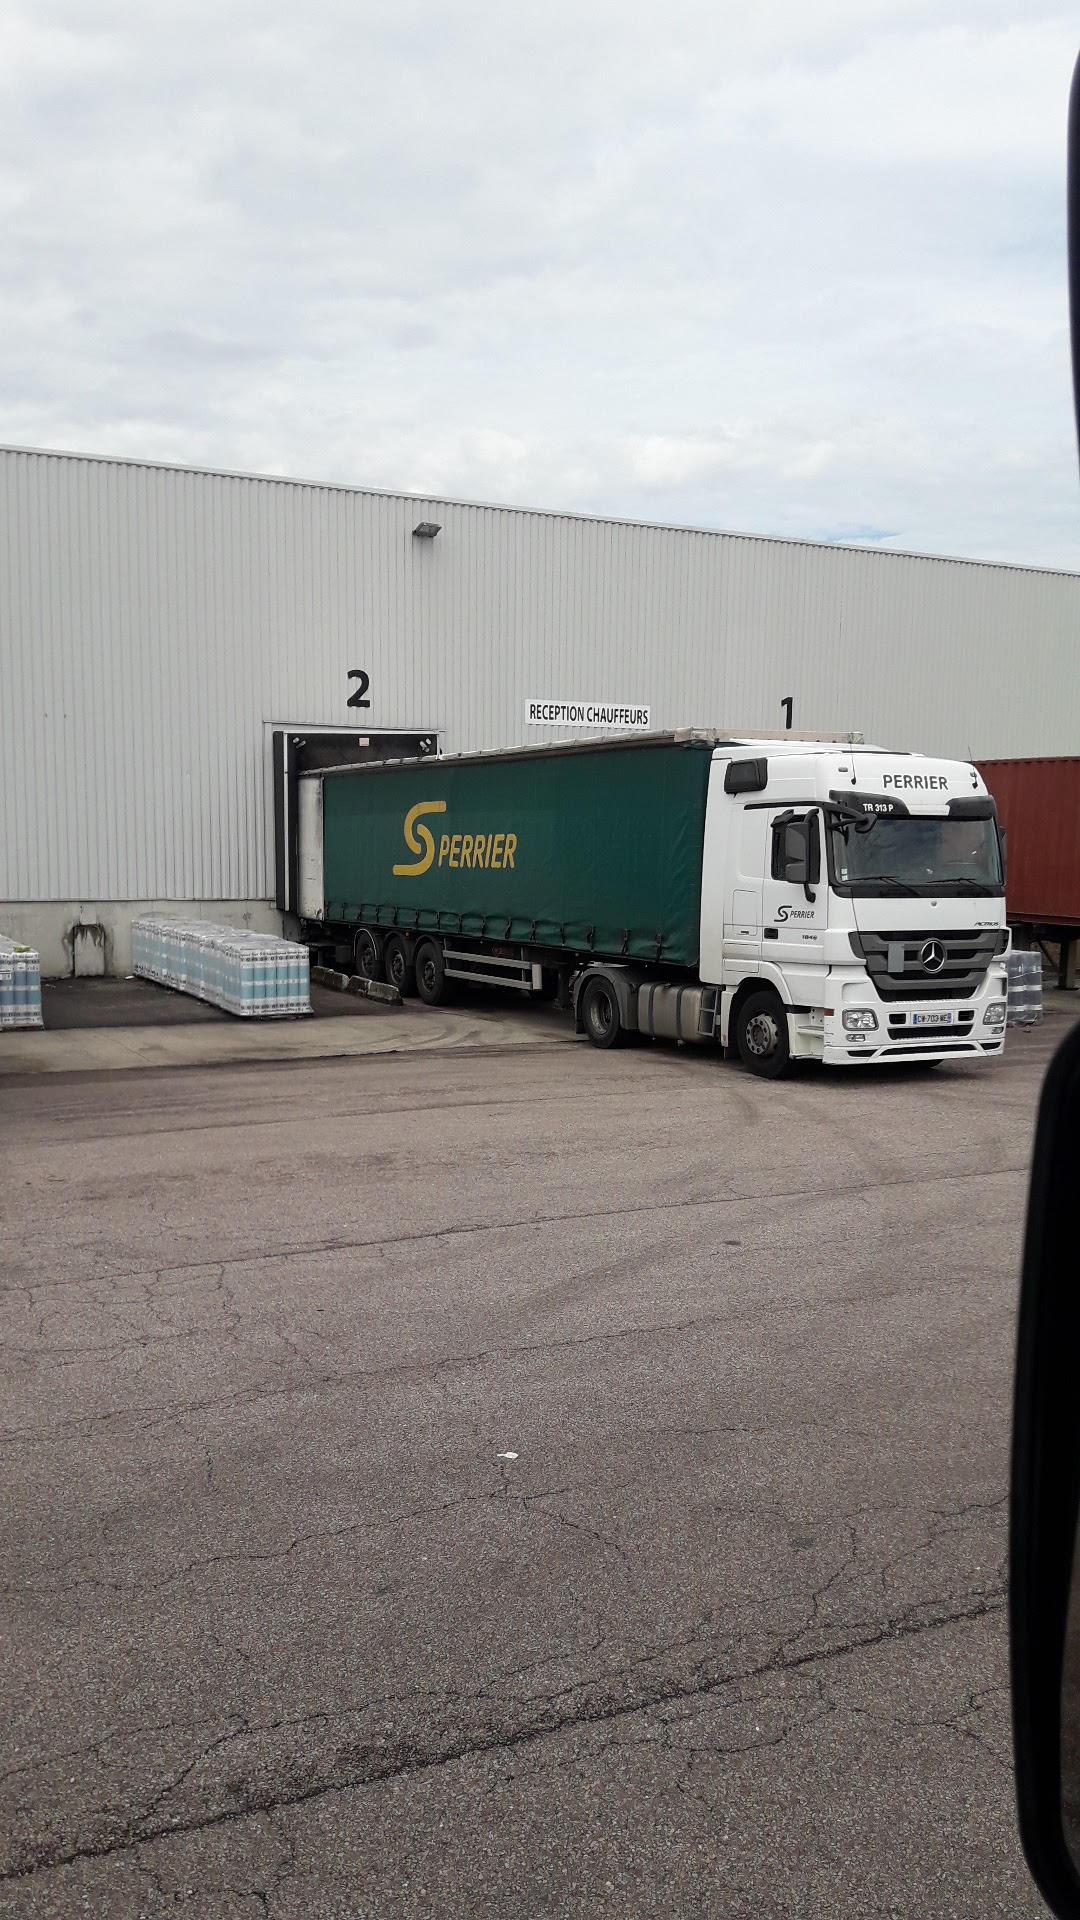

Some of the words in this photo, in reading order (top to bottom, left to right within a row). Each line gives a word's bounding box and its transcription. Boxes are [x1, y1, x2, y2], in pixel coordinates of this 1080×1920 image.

[346, 669, 371, 707] 2
[529, 704, 584, 722] RECEPTION
[586, 706, 649, 725] CHAUFFEURS
[781, 697, 793, 729] 1
[882, 774, 949, 790] PERRIER
[863, 803, 874, 812] TR
[875, 803, 888, 813] 313
[888, 804, 894, 813] P
[438, 834, 517, 869] PERRIER
[790, 910, 815, 919] PERRIER
